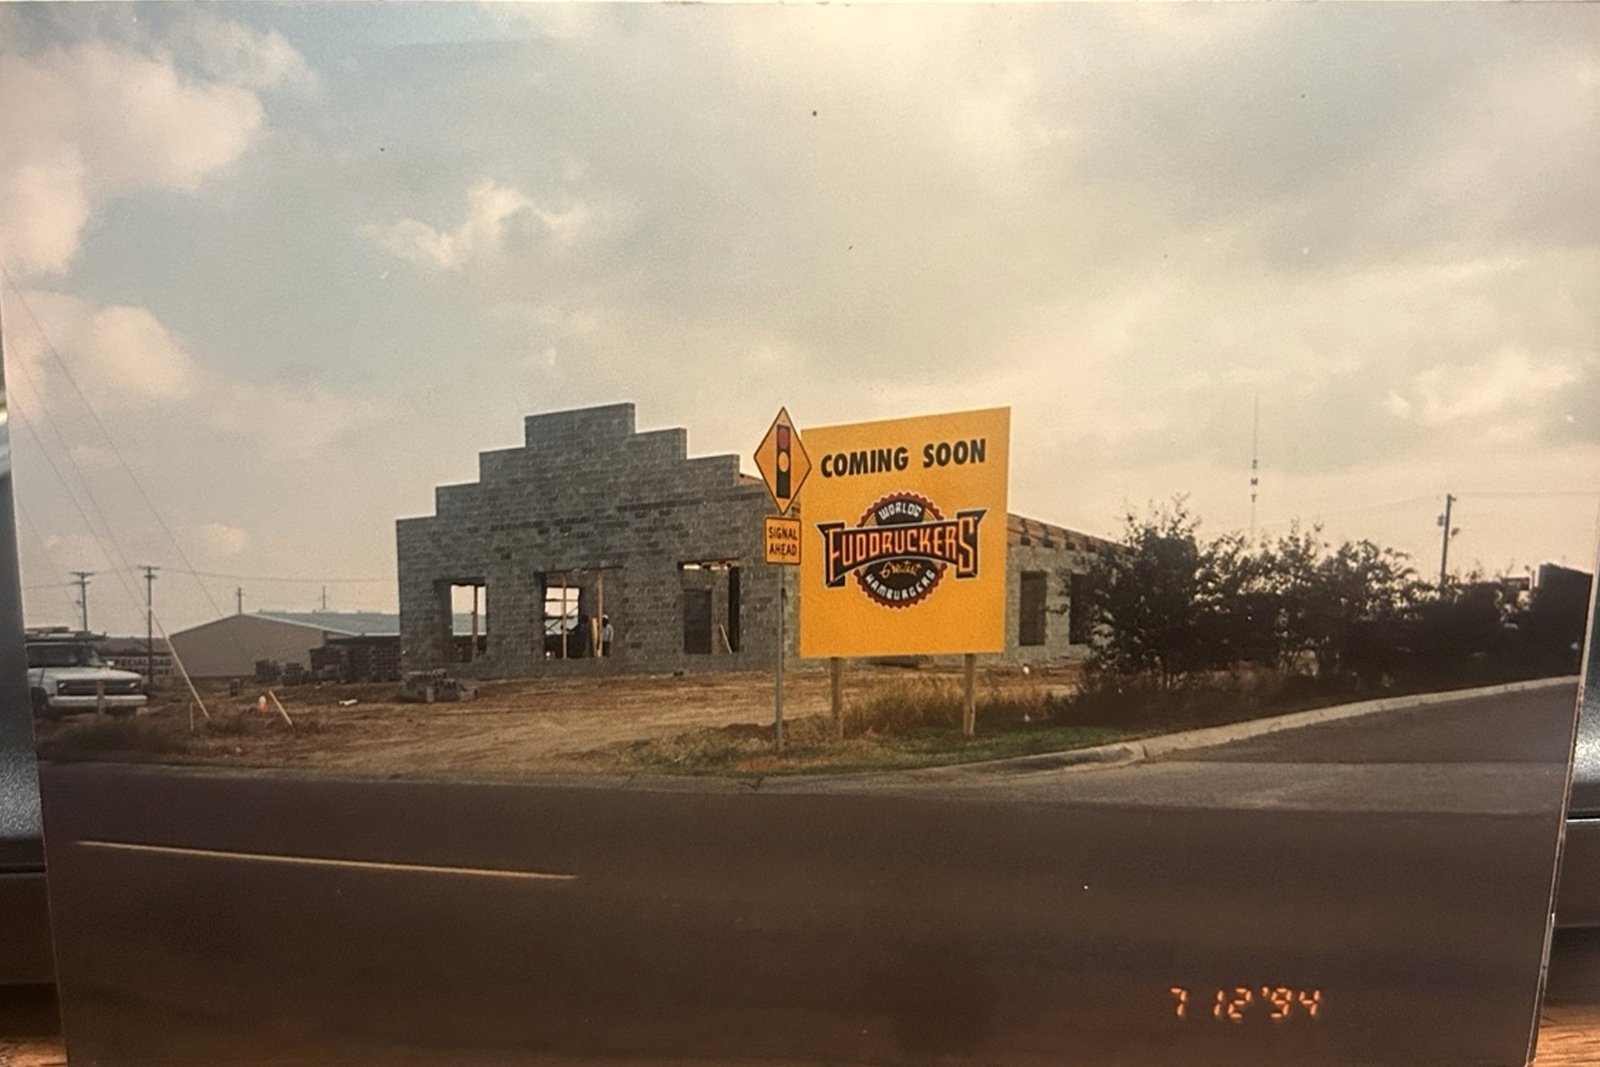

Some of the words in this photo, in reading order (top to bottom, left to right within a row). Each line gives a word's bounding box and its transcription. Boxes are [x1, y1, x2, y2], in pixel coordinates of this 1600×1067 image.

[821, 447, 908, 478] COMING
[923, 438, 986, 468] SOON
[768, 526, 798, 540] SIGNAL
[769, 543, 797, 556] AHEAD
[825, 513, 978, 585] FUDDRUCKERS
[865, 569, 936, 600] HAMBURGERS
